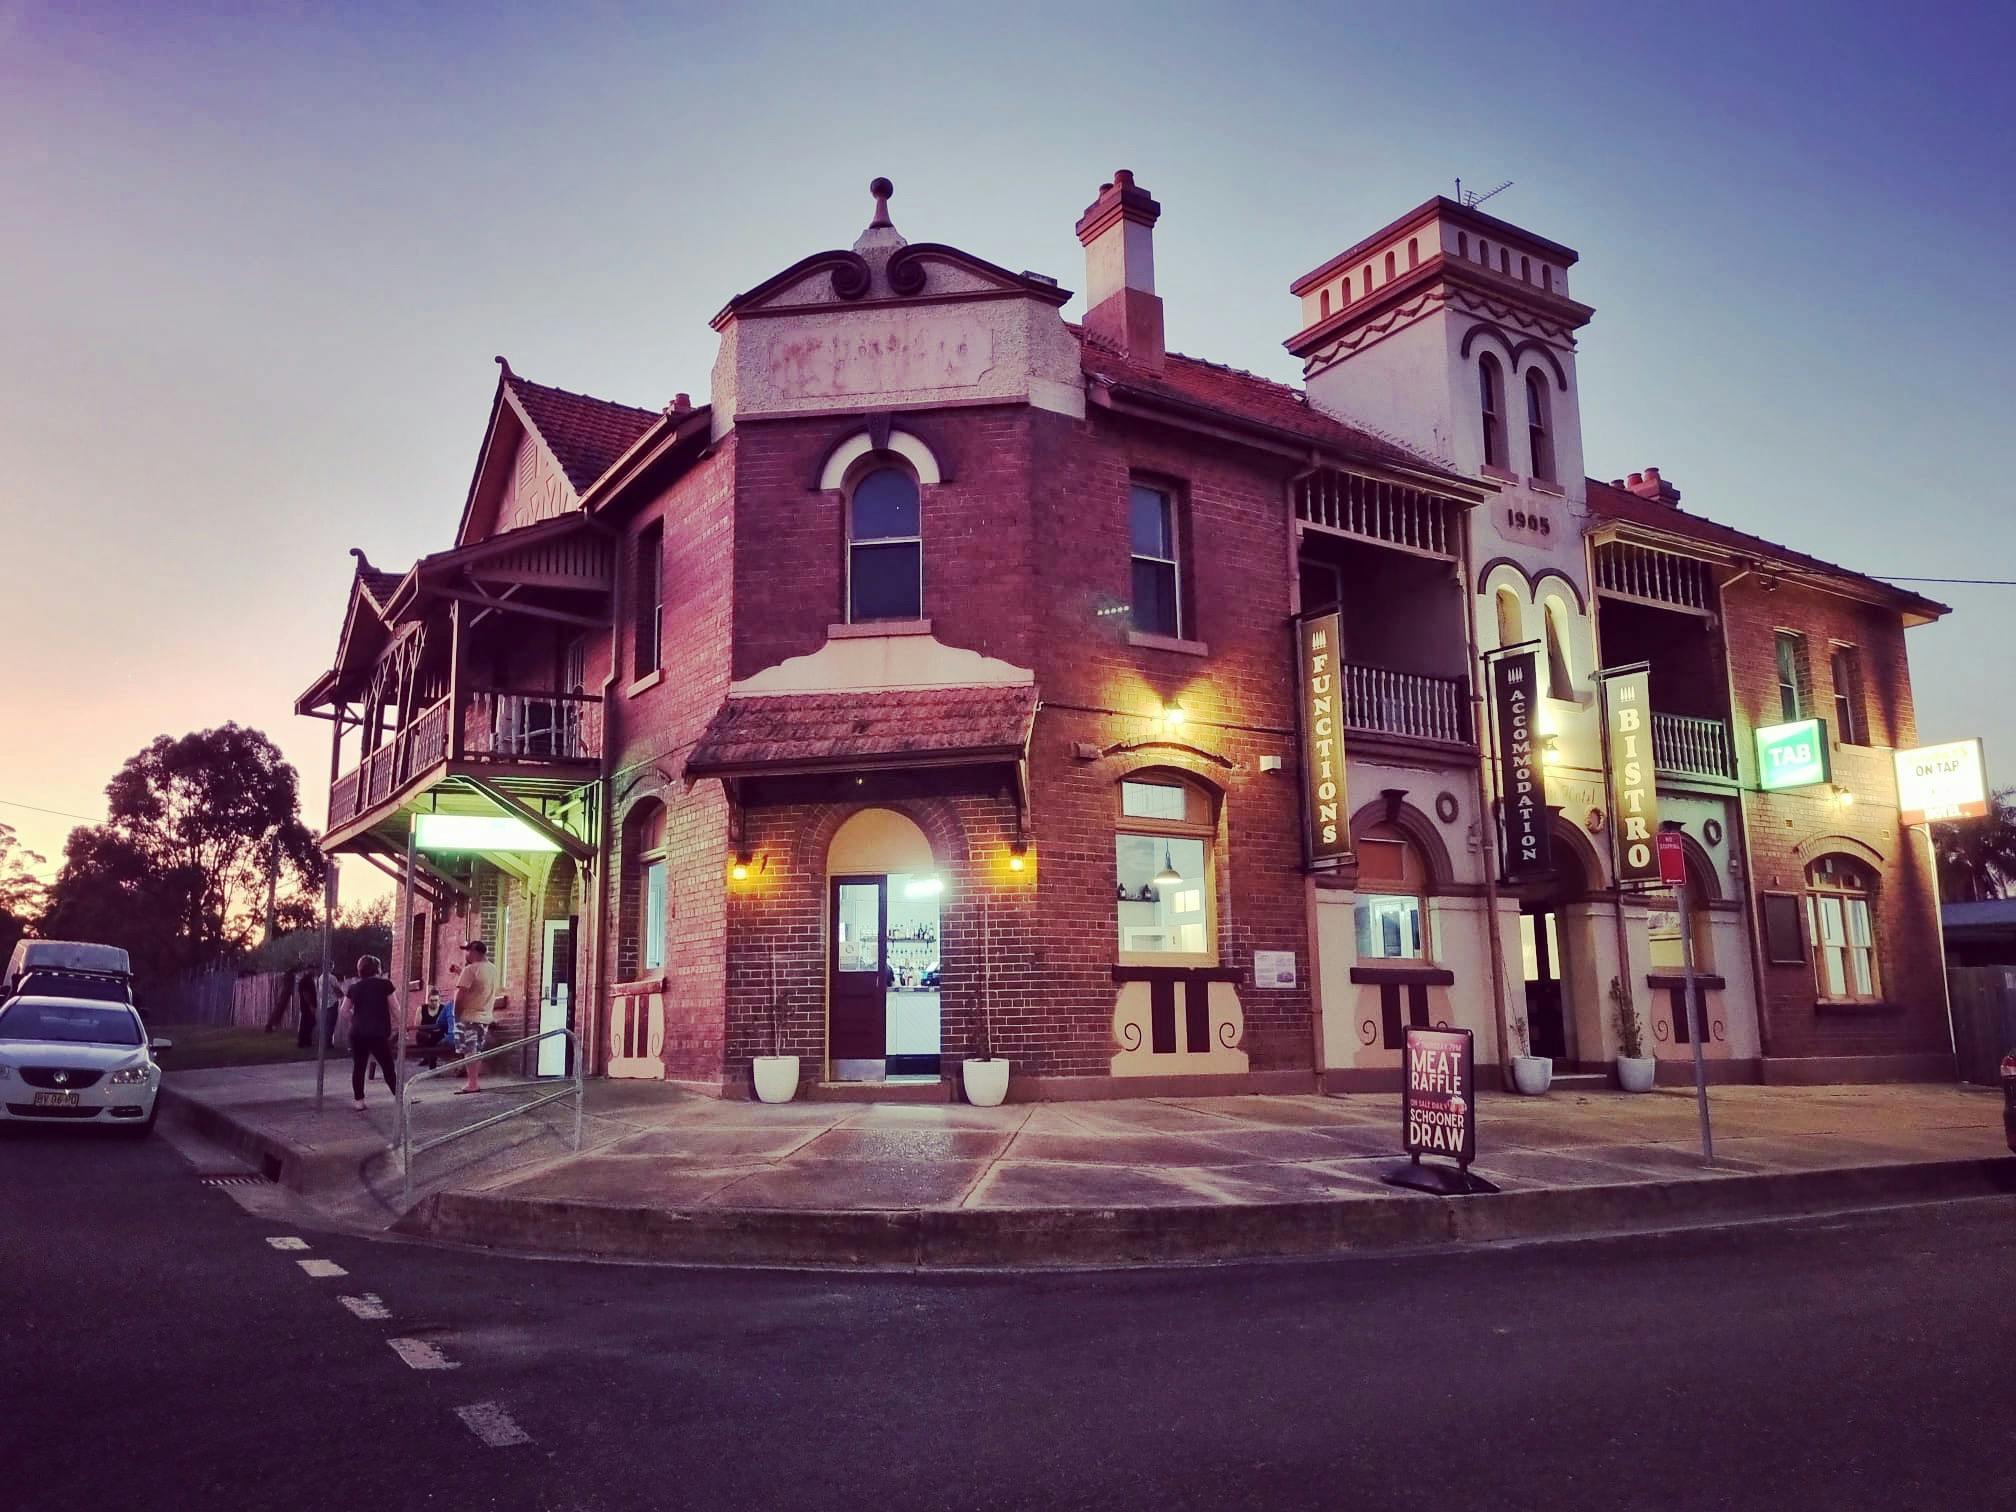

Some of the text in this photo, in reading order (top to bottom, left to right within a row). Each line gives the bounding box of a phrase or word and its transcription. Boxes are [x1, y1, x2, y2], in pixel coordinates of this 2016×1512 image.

[1508, 508, 1551, 537] 1905
[1311, 653, 1339, 844] FUNCTIONS
[1768, 743, 1811, 768] TAB
[1509, 689, 1537, 860] ACCOMMODATION
[1916, 760, 1960, 777] ON TAP
[1618, 708, 1651, 868] BISTRO
[1410, 1048, 1462, 1075] MEAT
[1411, 1072, 1462, 1095] RAFFLE
[1410, 1107, 1464, 1129] SCHOONER
[1410, 1121, 1465, 1152] DRAW
